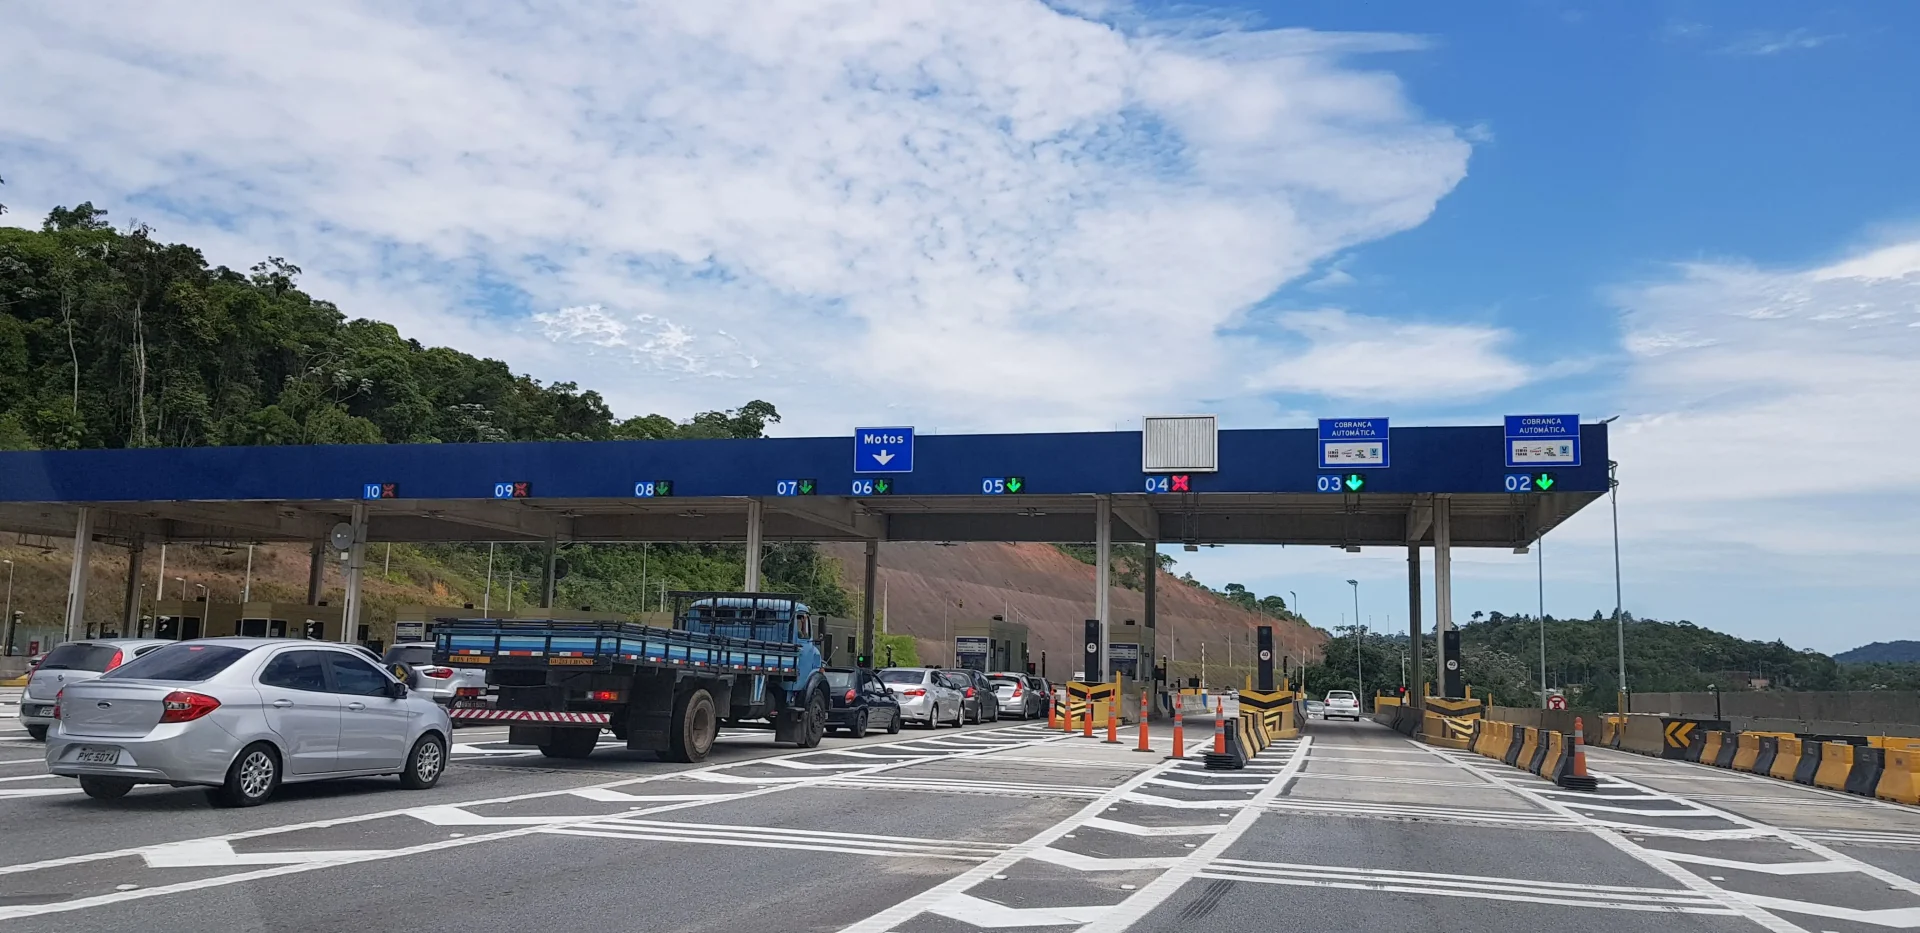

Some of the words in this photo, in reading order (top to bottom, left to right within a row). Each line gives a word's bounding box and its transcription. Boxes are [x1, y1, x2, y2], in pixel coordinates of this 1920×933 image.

[1334, 421, 1372, 429] COBRANÇA
[1519, 425, 1565, 434] AUTOMÁTICA
[864, 433, 904, 445] Motos
[1331, 428, 1376, 437] AUTOMÁTICA
[635, 483, 654, 496] 08
[777, 481, 797, 495] 07
[852, 481, 873, 494] 06
[983, 479, 1004, 493] 05
[1145, 477, 1168, 492] 04
[1318, 476, 1341, 491] 03
[1505, 475, 1531, 491] 02
[366, 485, 380, 498] 10
[495, 484, 514, 497] 09
